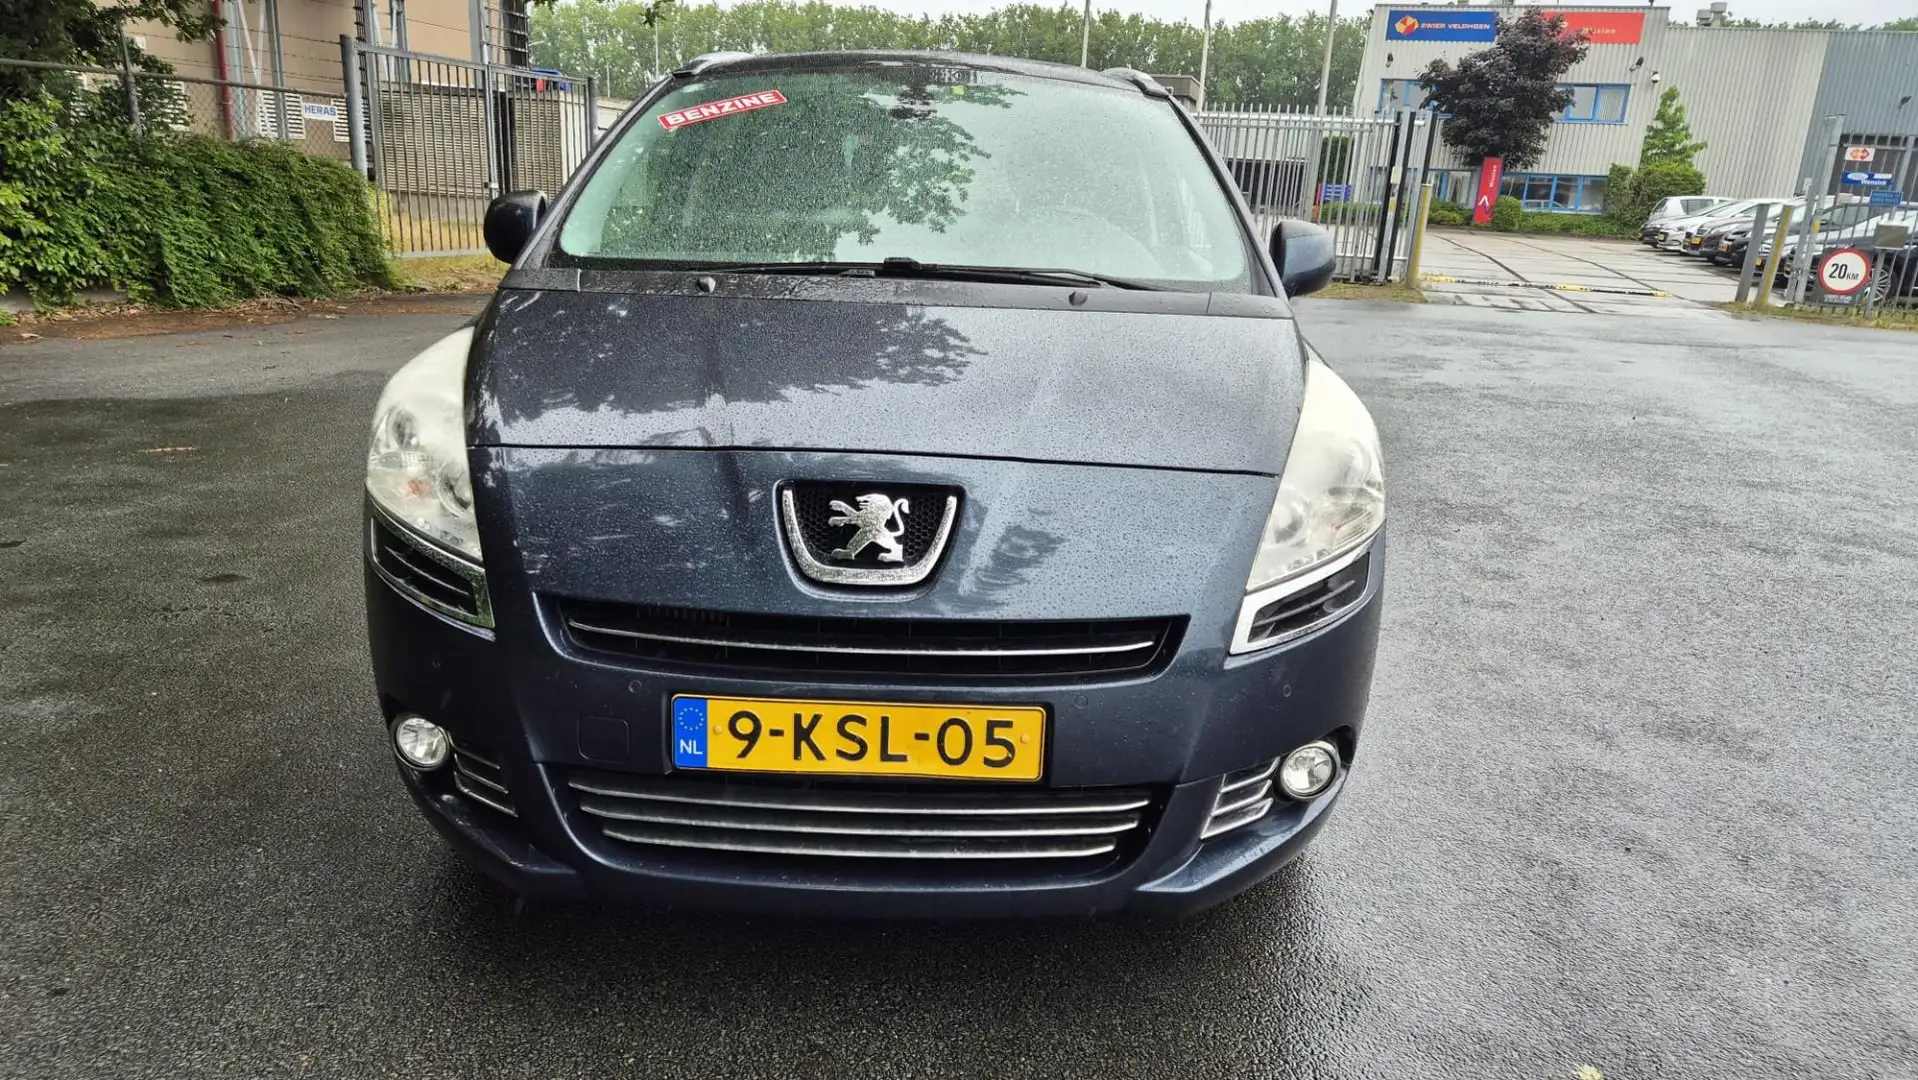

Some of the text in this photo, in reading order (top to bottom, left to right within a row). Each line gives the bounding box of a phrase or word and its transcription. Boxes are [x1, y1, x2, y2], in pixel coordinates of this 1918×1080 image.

[304, 103, 336, 117] HERAS
[665, 92, 776, 125] BENZINE
[1829, 263, 1859, 280] 20 KM
[680, 710, 1016, 768] NL 9-KSL-05
